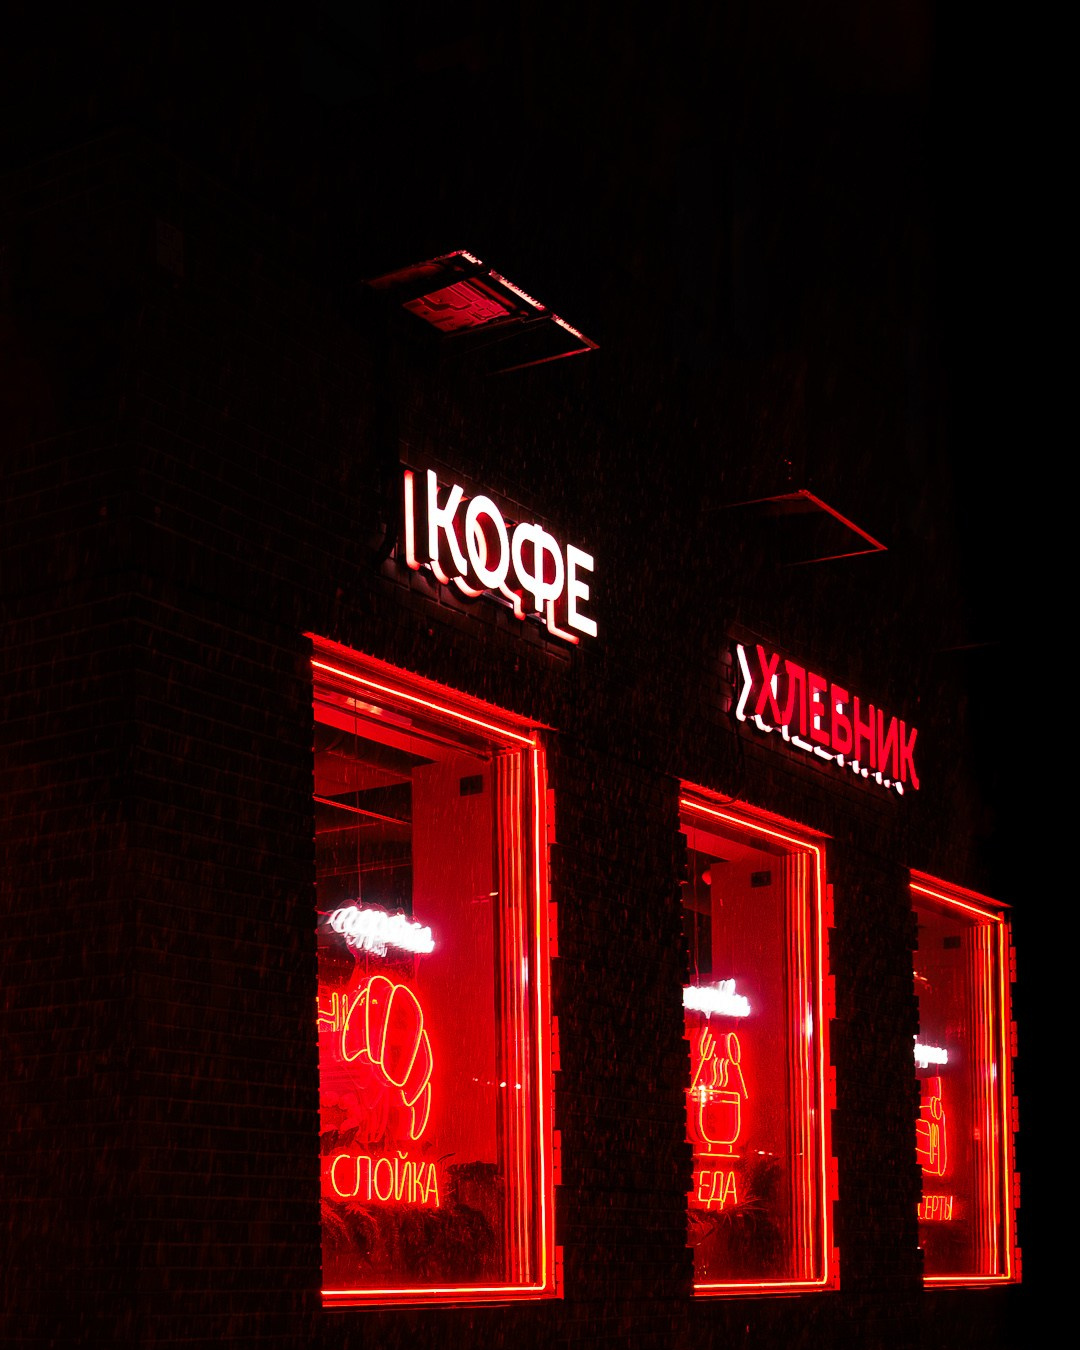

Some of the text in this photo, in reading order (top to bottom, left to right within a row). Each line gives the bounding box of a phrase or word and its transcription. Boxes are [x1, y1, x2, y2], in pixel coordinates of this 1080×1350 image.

[426, 468, 598, 640] КОФЕ
[754, 644, 920, 792] ХЛЕБНИК
[331, 1150, 440, 1207] СЛОЙКА
[698, 1170, 738, 1210] ЕДА
